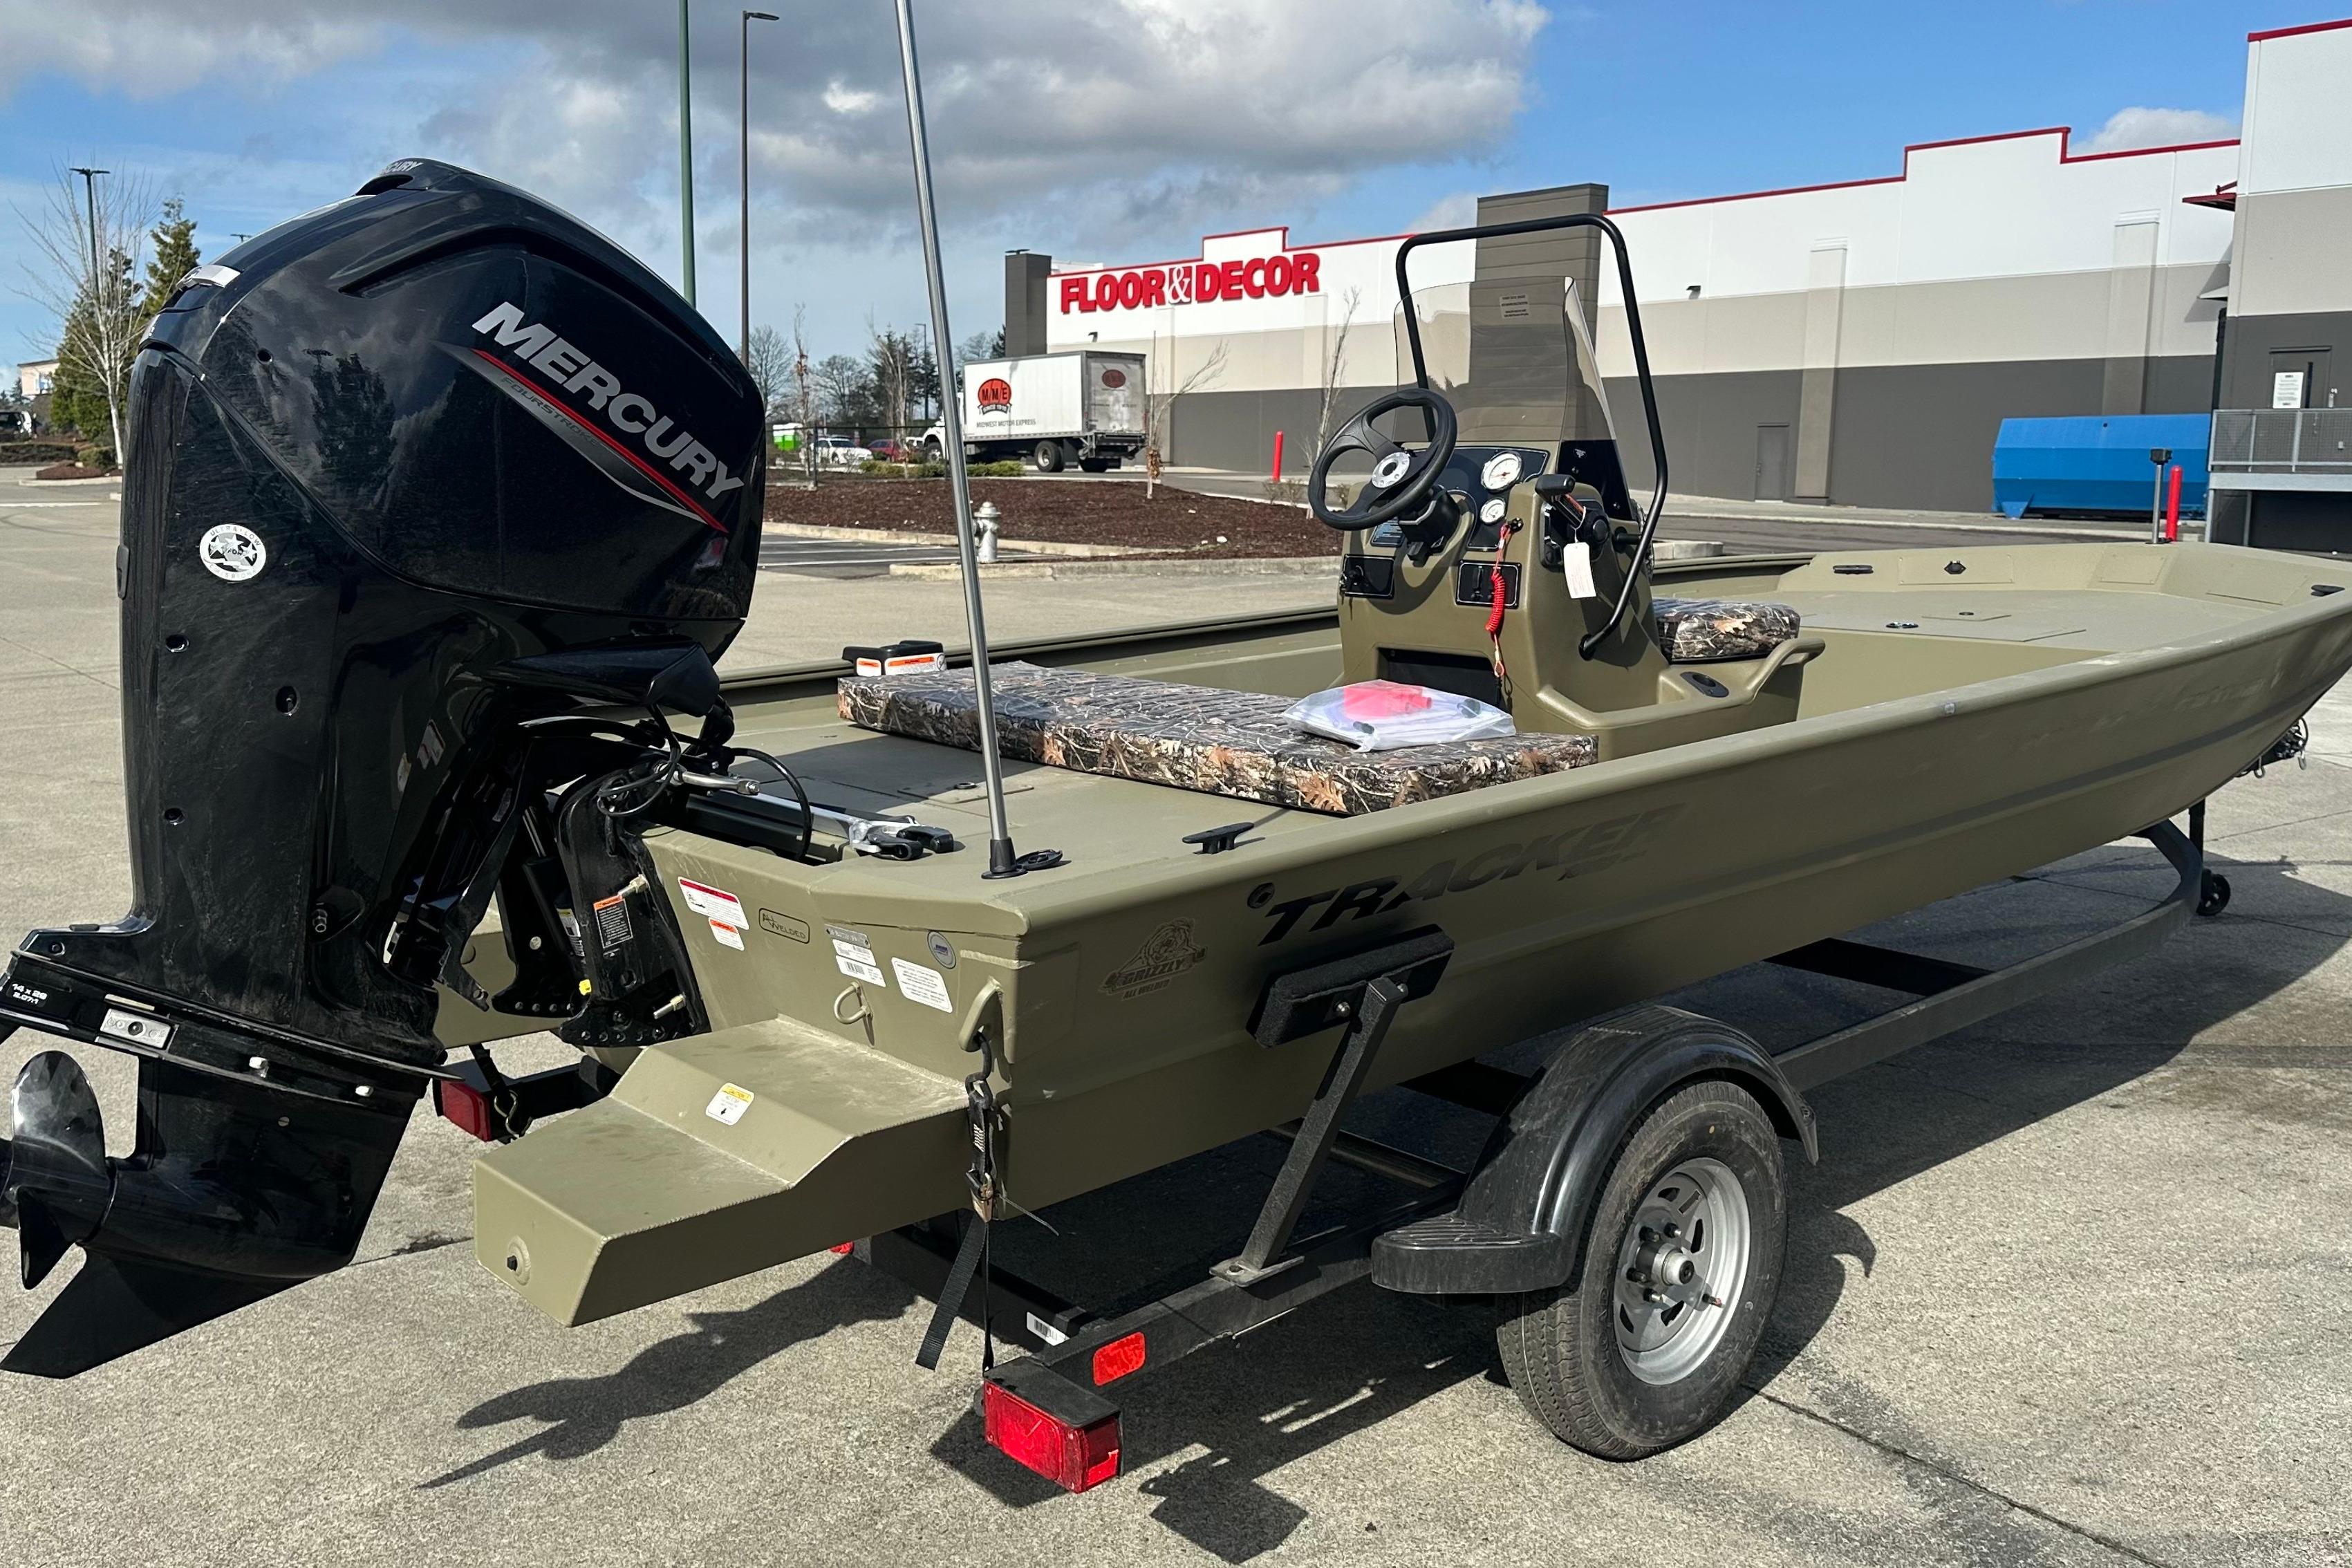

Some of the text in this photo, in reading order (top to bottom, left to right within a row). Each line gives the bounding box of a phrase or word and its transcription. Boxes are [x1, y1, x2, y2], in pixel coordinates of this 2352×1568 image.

[1061, 253, 1320, 314] FLOOR & DECOR
[472, 301, 744, 499] MERCURY
[501, 377, 598, 447] FOURSTROKE
